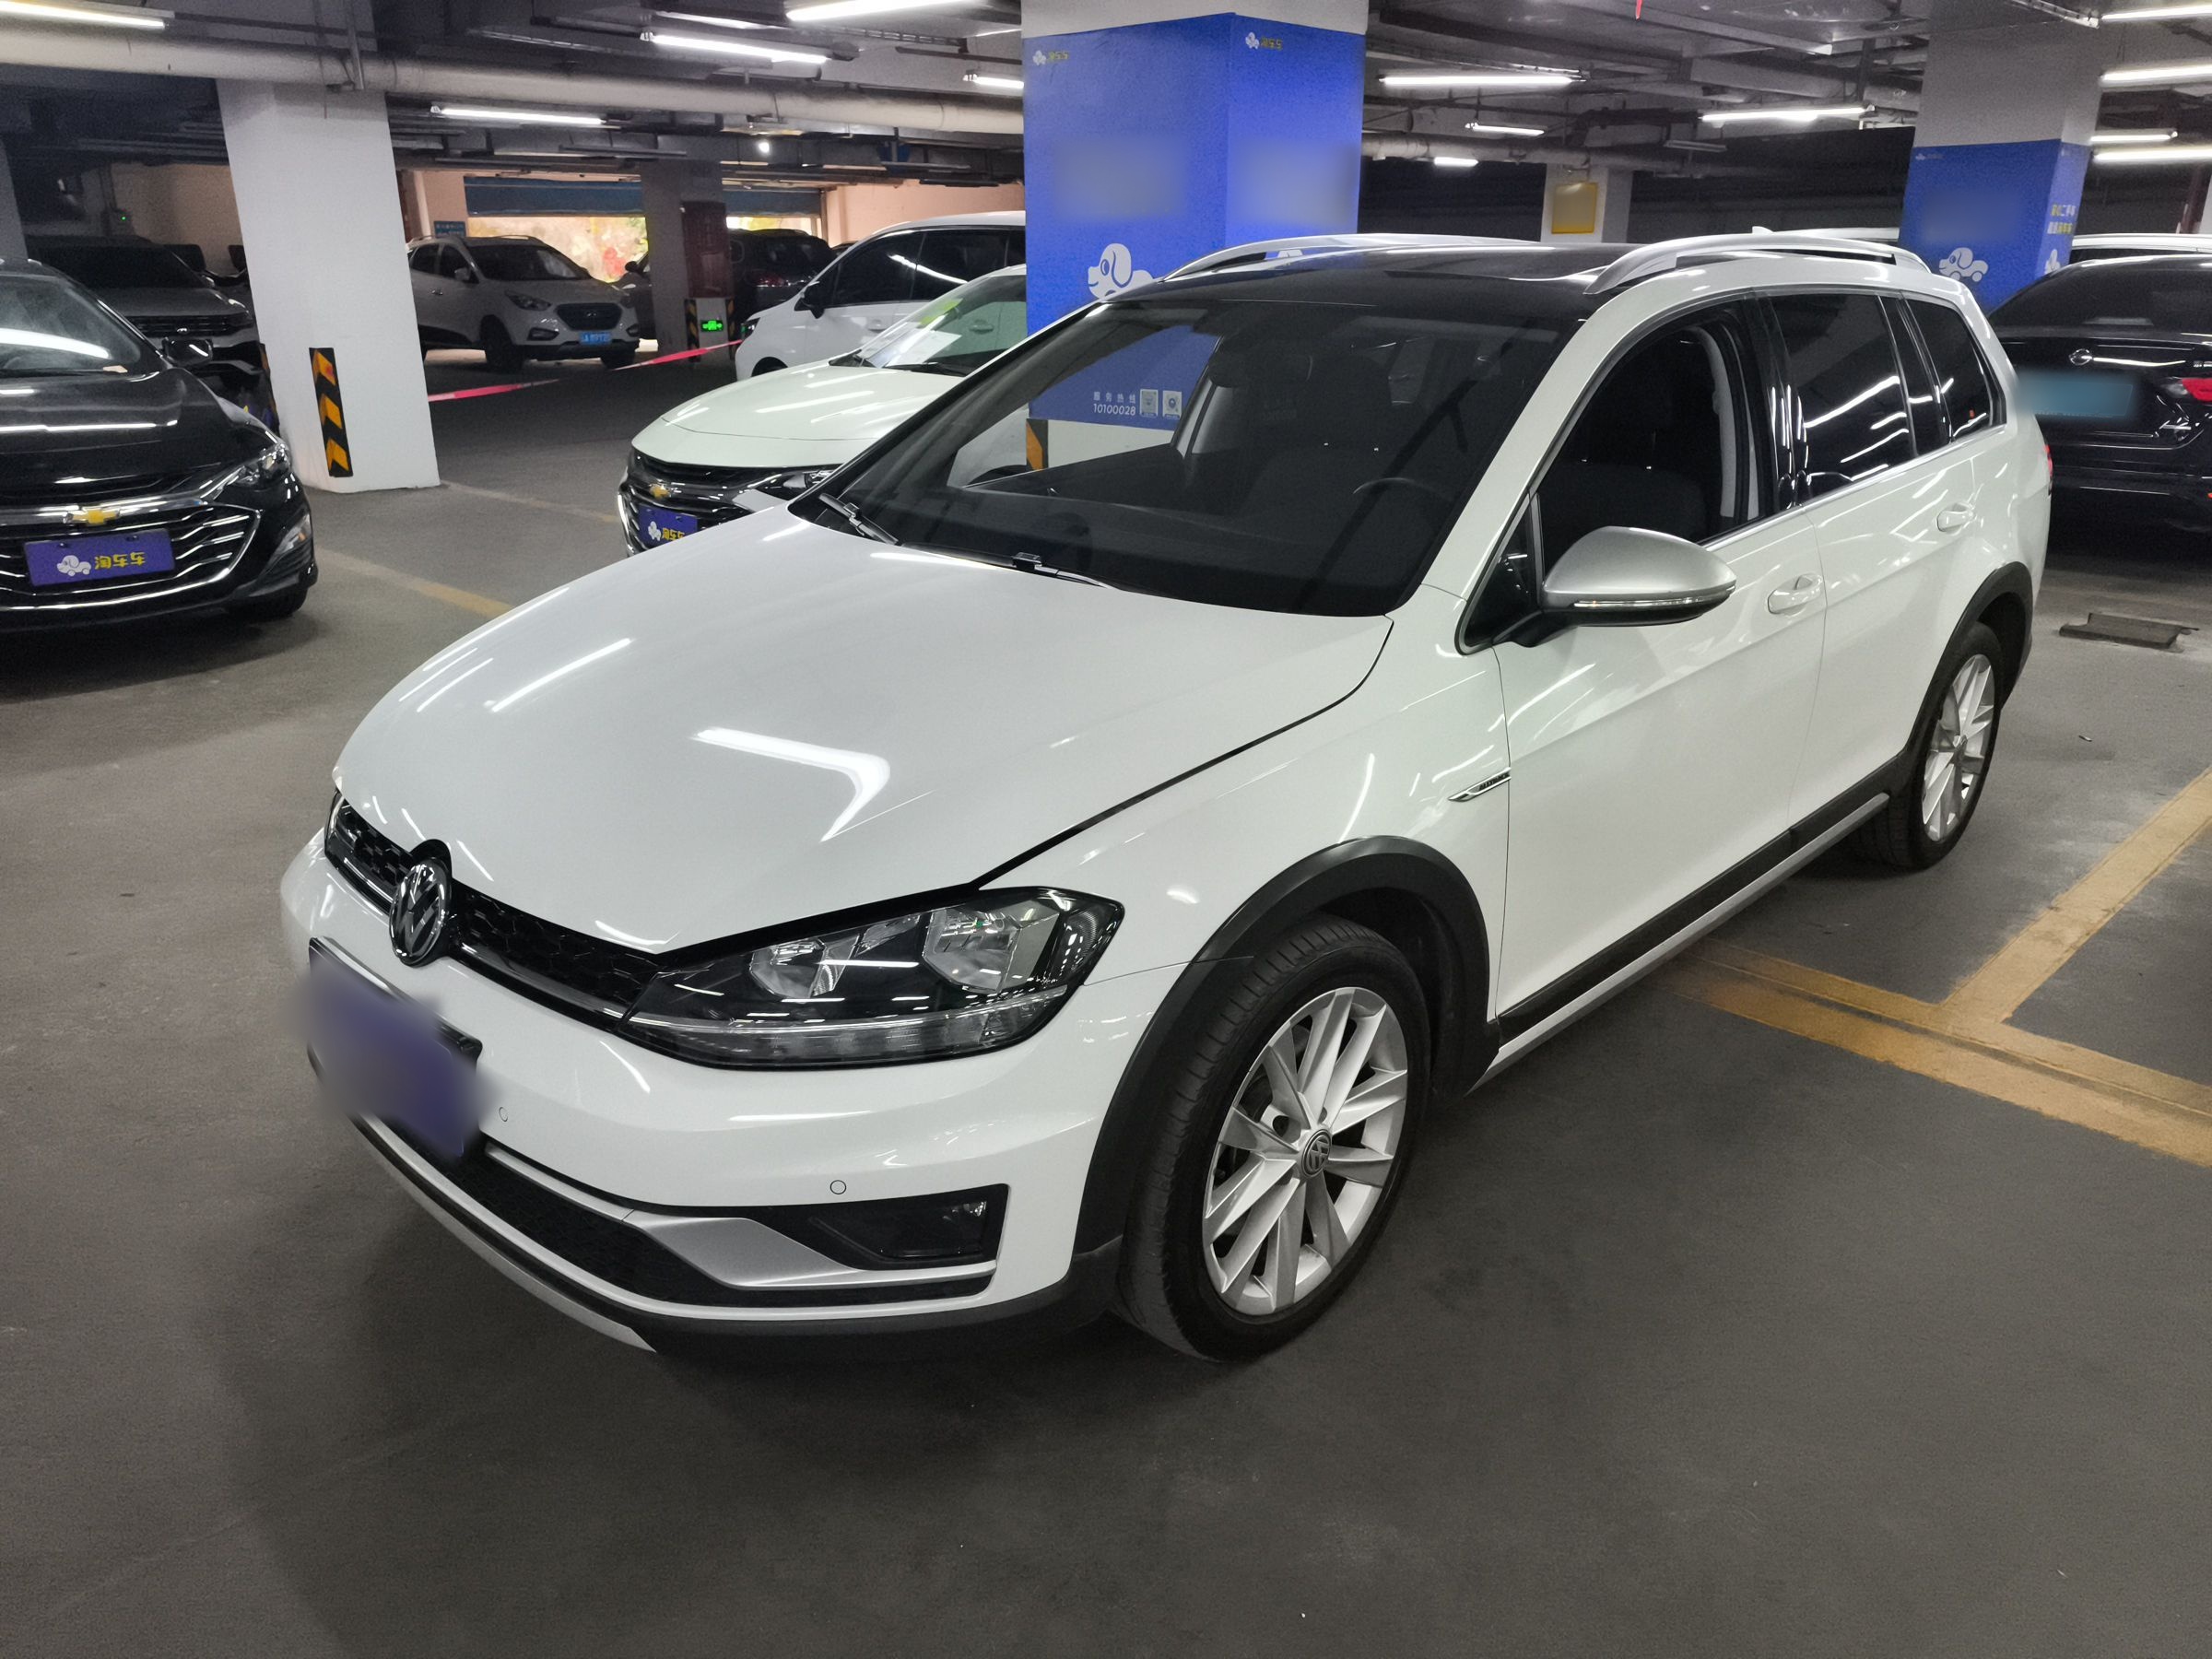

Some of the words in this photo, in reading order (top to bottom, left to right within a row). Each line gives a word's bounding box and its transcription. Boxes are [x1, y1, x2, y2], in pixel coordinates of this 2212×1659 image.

[1093, 404, 1136, 417] 10100028
[94, 551, 146, 571] 淘车车
